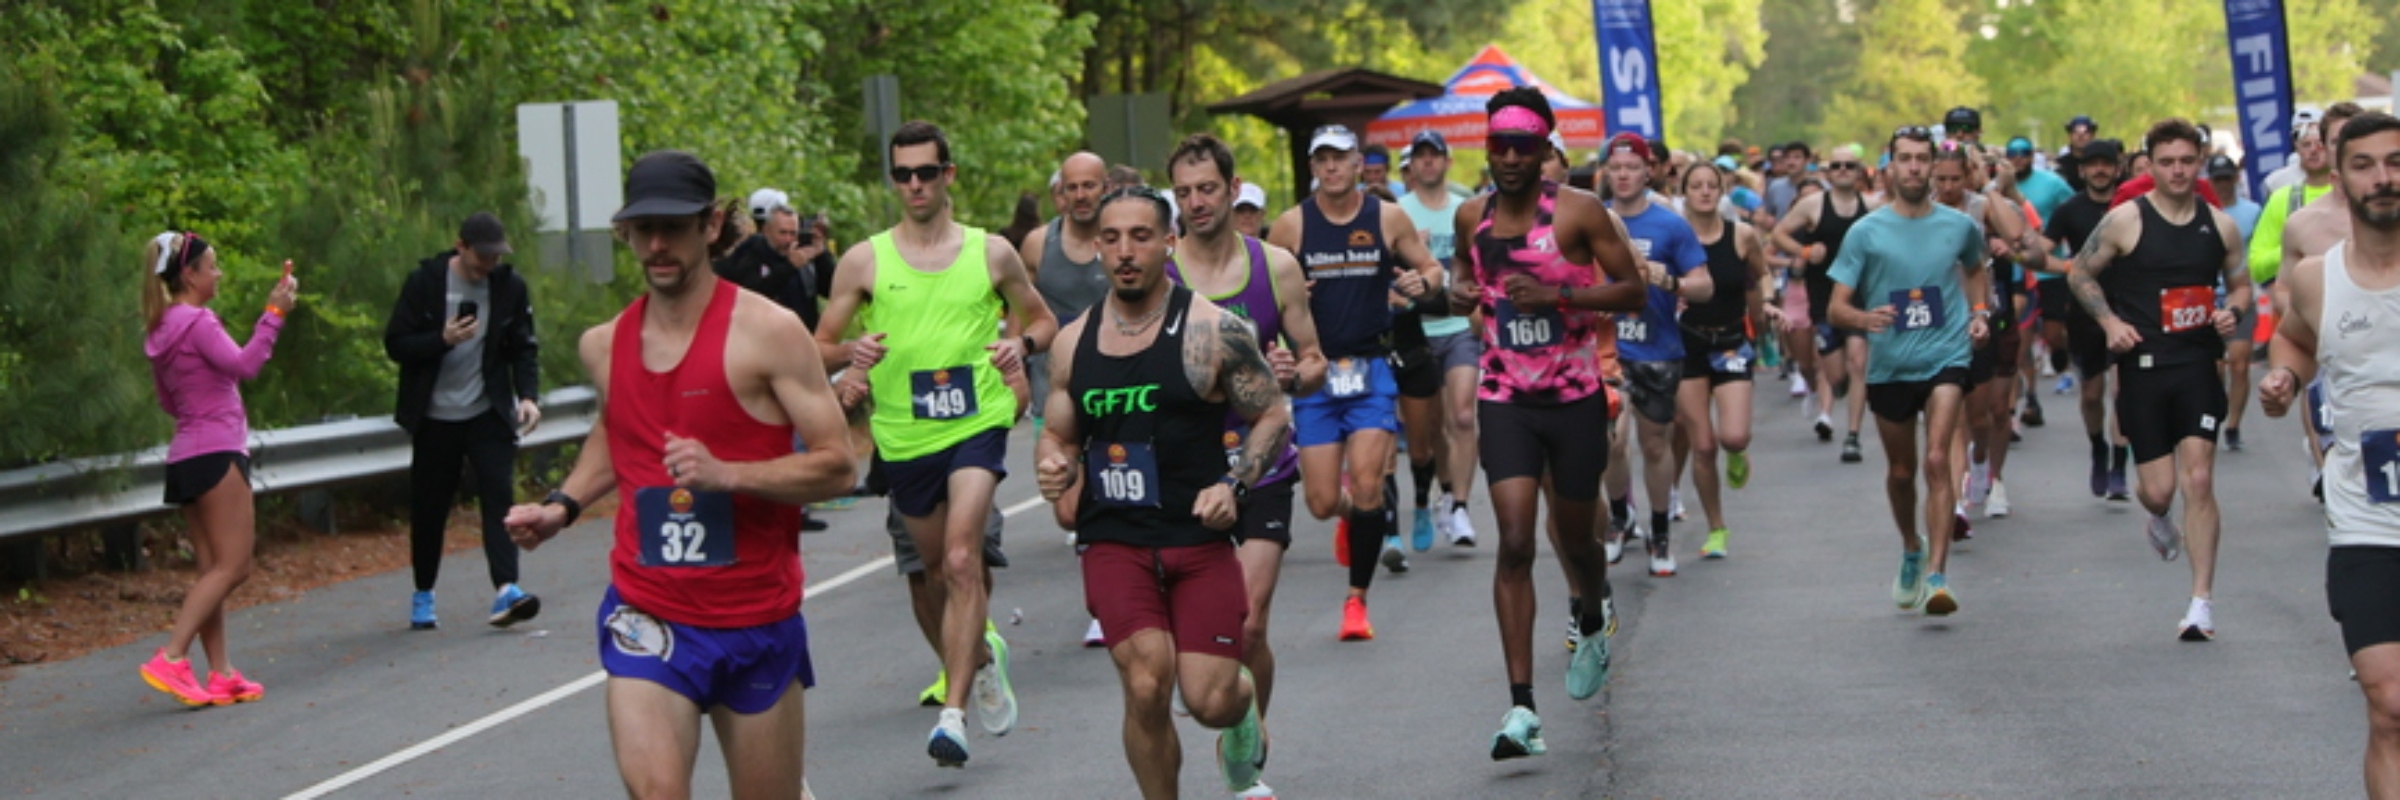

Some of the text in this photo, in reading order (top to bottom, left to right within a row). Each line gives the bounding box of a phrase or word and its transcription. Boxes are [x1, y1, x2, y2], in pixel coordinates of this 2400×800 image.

[1609, 46, 1655, 136] ST
[2235, 33, 2284, 174] FINI
[1346, 249, 1380, 262] head
[1617, 321, 1646, 342] 124
[1905, 304, 1932, 328] 25
[2172, 304, 2206, 328] 523
[1507, 318, 1551, 346] 160
[926, 388, 966, 418] 149
[1082, 383, 1162, 417] GFTC
[1100, 469, 1146, 501] 109
[2380, 460, 2400, 496] 1
[660, 521, 706, 562] 32
